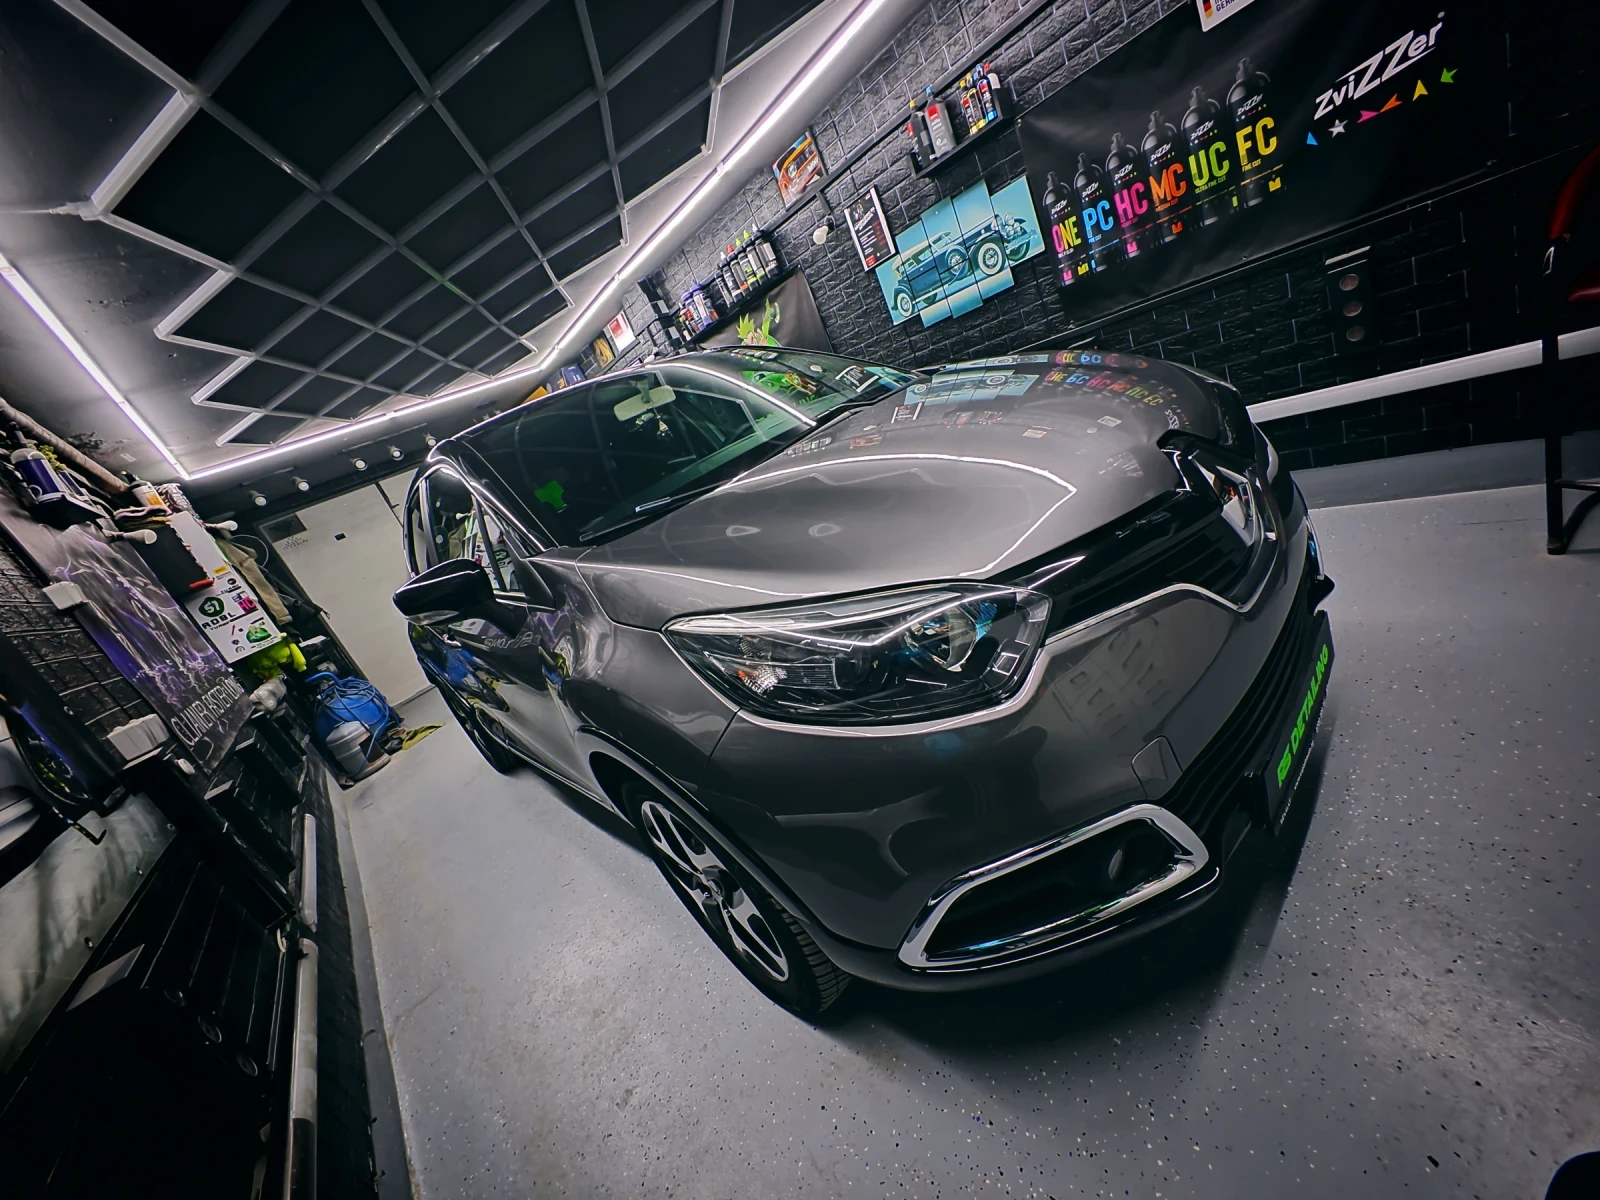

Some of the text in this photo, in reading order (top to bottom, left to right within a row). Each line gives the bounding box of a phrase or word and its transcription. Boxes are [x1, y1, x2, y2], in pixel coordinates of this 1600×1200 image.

[1236, 116, 1278, 166] FC
[1149, 163, 1187, 207] MC
[1188, 141, 1230, 187] UC
[1082, 200, 1114, 239] PC
[1113, 182, 1149, 223] HC
[1052, 215, 1082, 253] ONE
[1291, 644, 1329, 754] DETAILING
